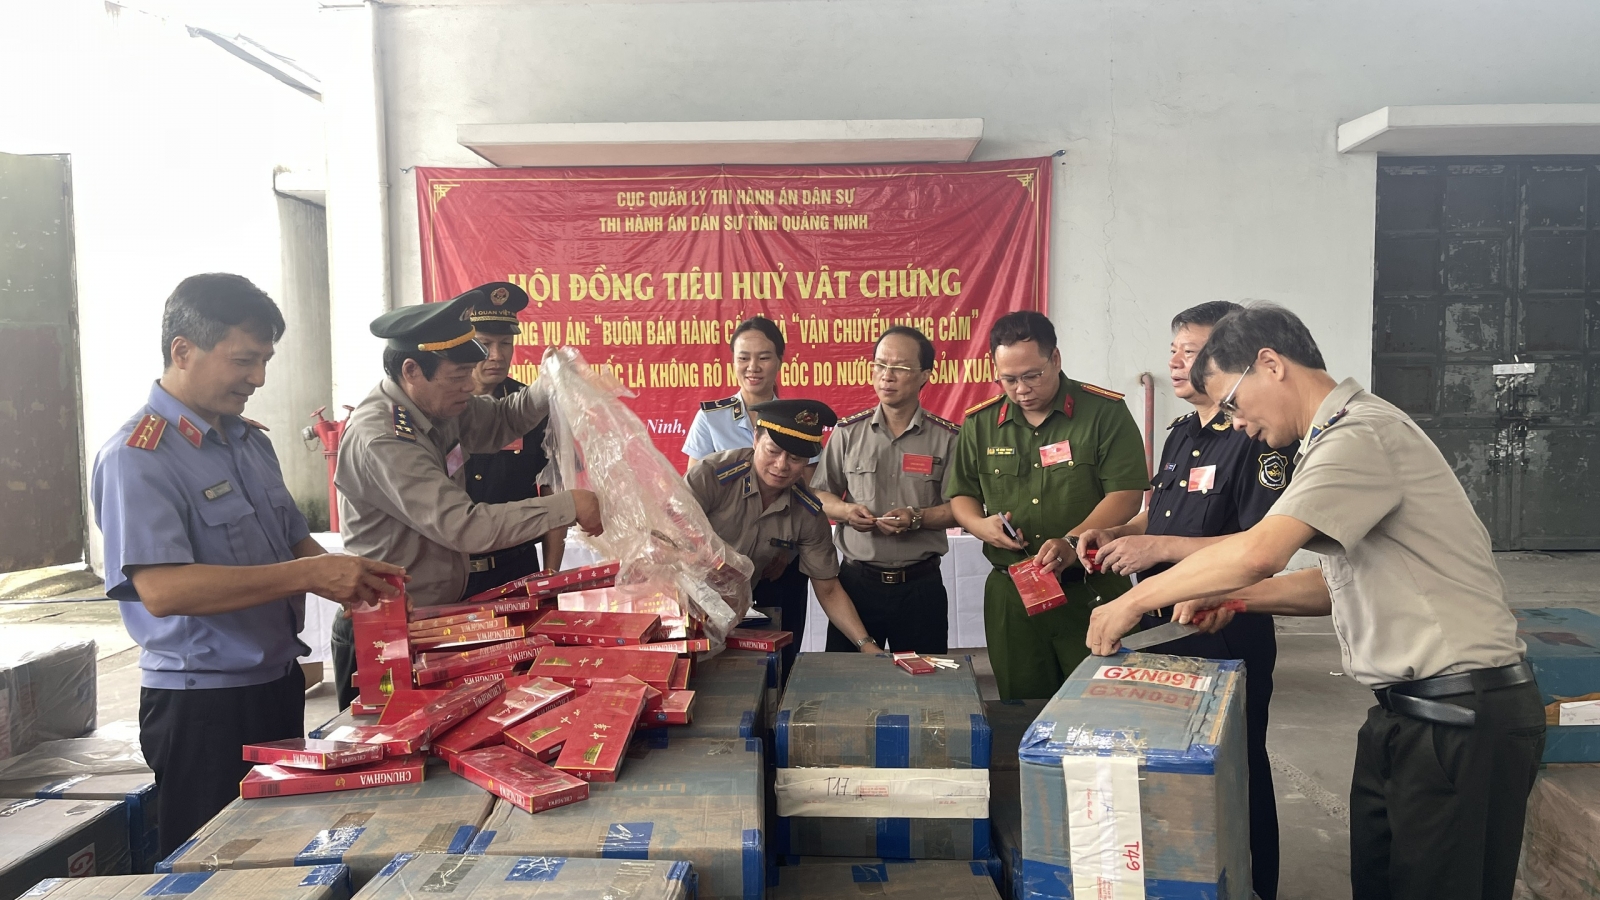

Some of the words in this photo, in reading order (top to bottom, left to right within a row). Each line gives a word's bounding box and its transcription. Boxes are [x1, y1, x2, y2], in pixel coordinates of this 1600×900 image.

[617, 191, 645, 210] CỤC
[649, 186, 687, 208] QUẢN
[691, 187, 708, 206] LÝ
[711, 189, 732, 205] THI
[736, 187, 775, 205] HÀNH
[778, 187, 798, 205] ÁN
[802, 187, 831, 205] DÂN
[836, 188, 856, 208] SỰ
[599, 217, 621, 232] THI
[625, 214, 663, 232] HÀNH
[667, 213, 687, 231] ÁN
[691, 213, 720, 231] DÂN
[724, 214, 744, 234] SỰ
[746, 210, 778, 230] TỈNH
[782, 210, 829, 232] QUẢNG
[833, 214, 868, 230] NINH
[569, 264, 654, 301] ĐỒNG
[663, 266, 723, 300] TIÊU
[732, 263, 788, 300] HUỶ
[795, 265, 851, 306] VẬT
[859, 263, 962, 298] CHỨNG
[565, 316, 591, 346] ÁN:
[594, 314, 642, 345] “BUÔN
[646, 315, 677, 345] BÁN
[680, 315, 720, 345] HÀNG
[628, 358, 647, 388] LÁ
[650, 357, 699, 388] KHÔNG
[703, 357, 722, 388] RÕ
[780, 353, 809, 387] GỐC
[813, 361, 833, 386] DO
[929, 350, 959, 384] SẢN
[646, 418, 686, 437] Ninh,
[1103, 666, 1203, 689] GXN09T
[1089, 685, 1196, 707] GXN09T
[360, 770, 412, 786] CHUNGHWA
[1122, 841, 1141, 872] T49
